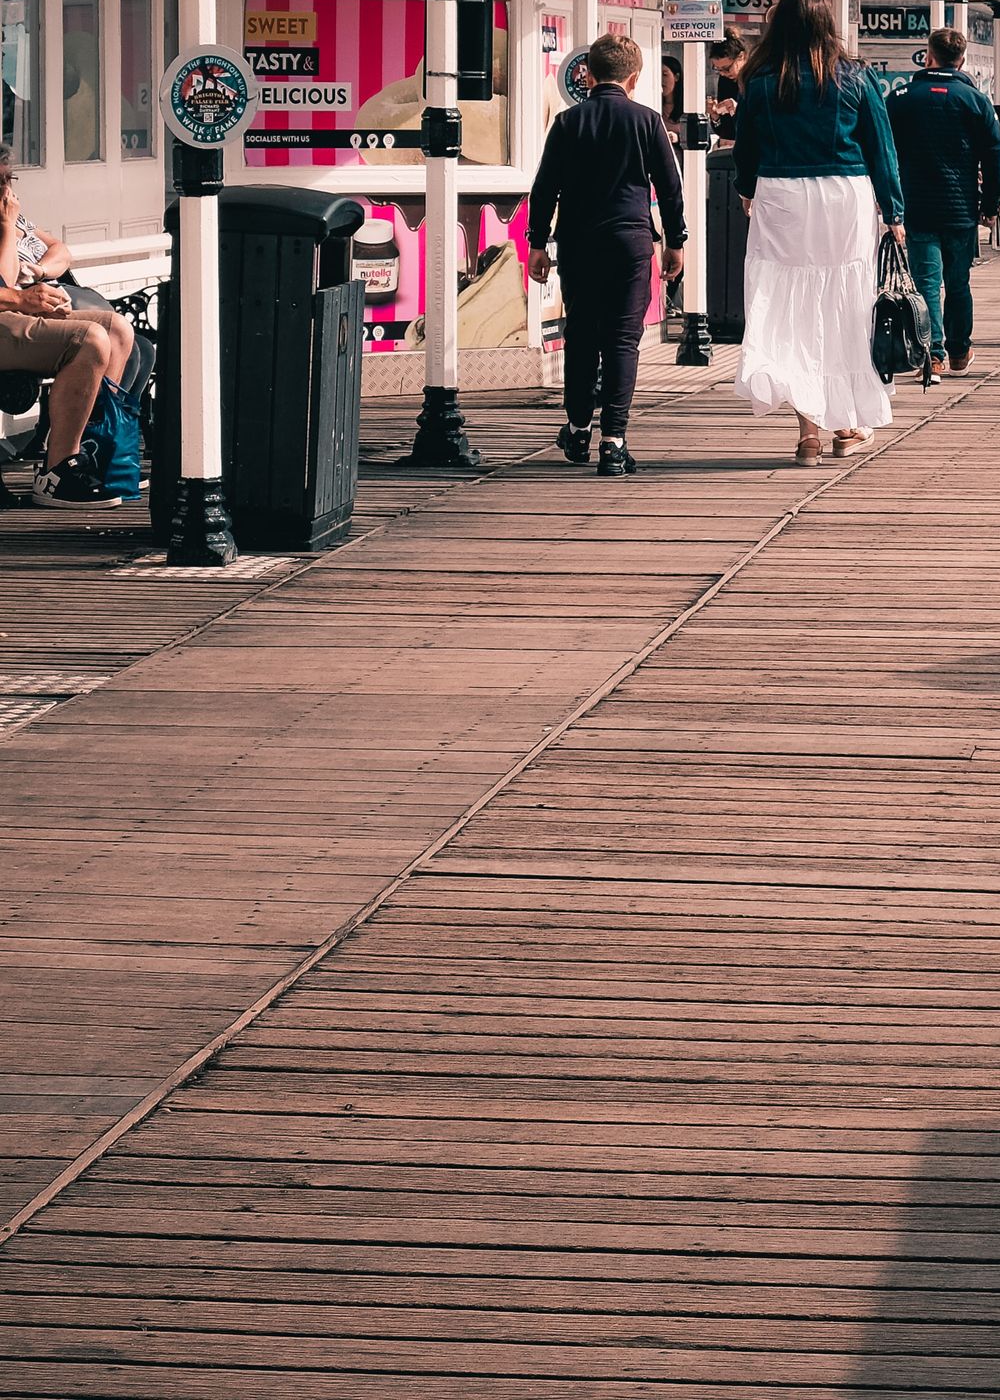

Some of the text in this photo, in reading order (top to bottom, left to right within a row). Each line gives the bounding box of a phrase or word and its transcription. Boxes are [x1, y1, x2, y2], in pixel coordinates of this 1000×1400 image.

[247, 17, 308, 35] SWEET
[670, 22, 716, 30] KEEP YOUR
[859, 13, 929, 31] LUSH BA
[672, 31, 715, 39] DISTANCE!
[246, 52, 315, 71] TASTY &
[173, 78, 183, 104] HOME
[179, 67, 188, 80] TO
[204, 57, 240, 78] BRIGHTON
[237, 78, 246, 103] MUSC
[261, 87, 347, 105] ELICIOUS
[182, 116, 205, 134] WALK
[214, 115, 238, 134] FAME
[246, 135, 310, 143] SOCIALISE WITH US
[360, 268, 392, 279] nutella
